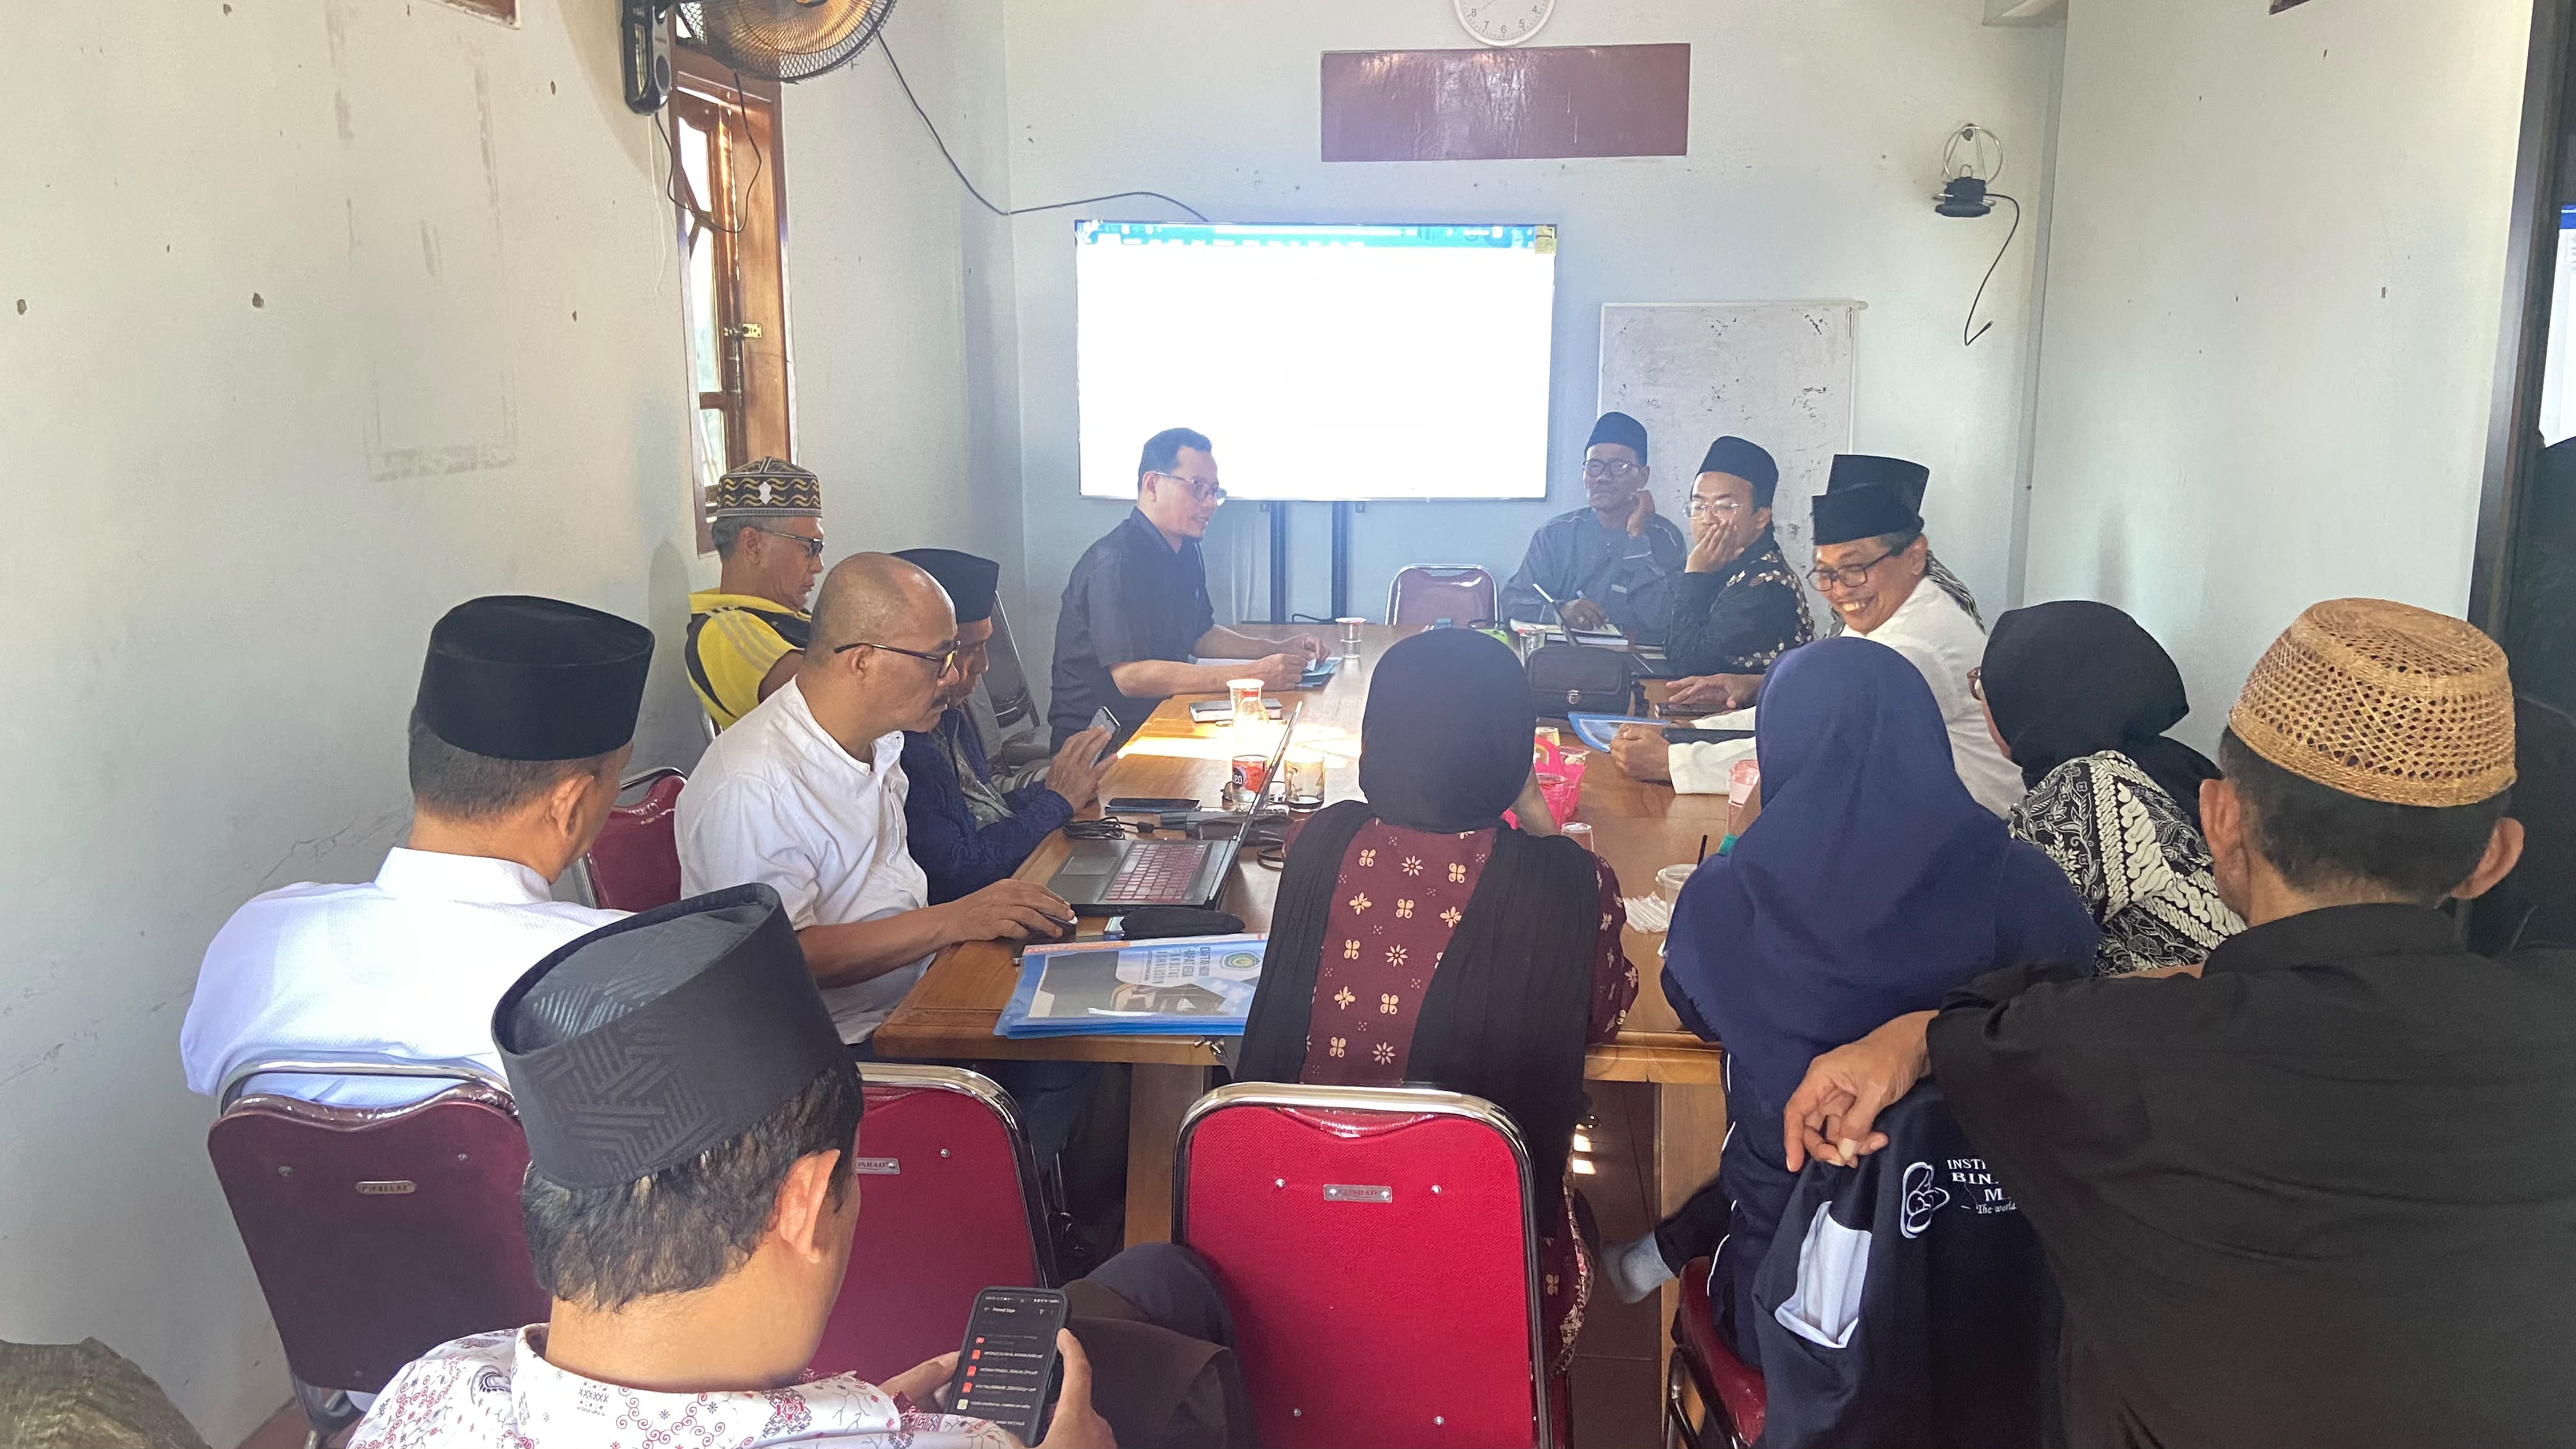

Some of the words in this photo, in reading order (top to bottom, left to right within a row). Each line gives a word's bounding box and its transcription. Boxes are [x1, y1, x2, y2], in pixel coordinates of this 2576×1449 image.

[1471, 8, 1477, 17] 8
[1531, 5, 1538, 13] 4
[1483, 20, 1490, 29] 7
[1519, 19, 1525, 27] 5
[1501, 25, 1507, 34] 6
[1952, 1172, 1998, 1184] BIN
[1984, 1188, 2007, 1202] M
[1977, 1204, 1993, 1214] The
